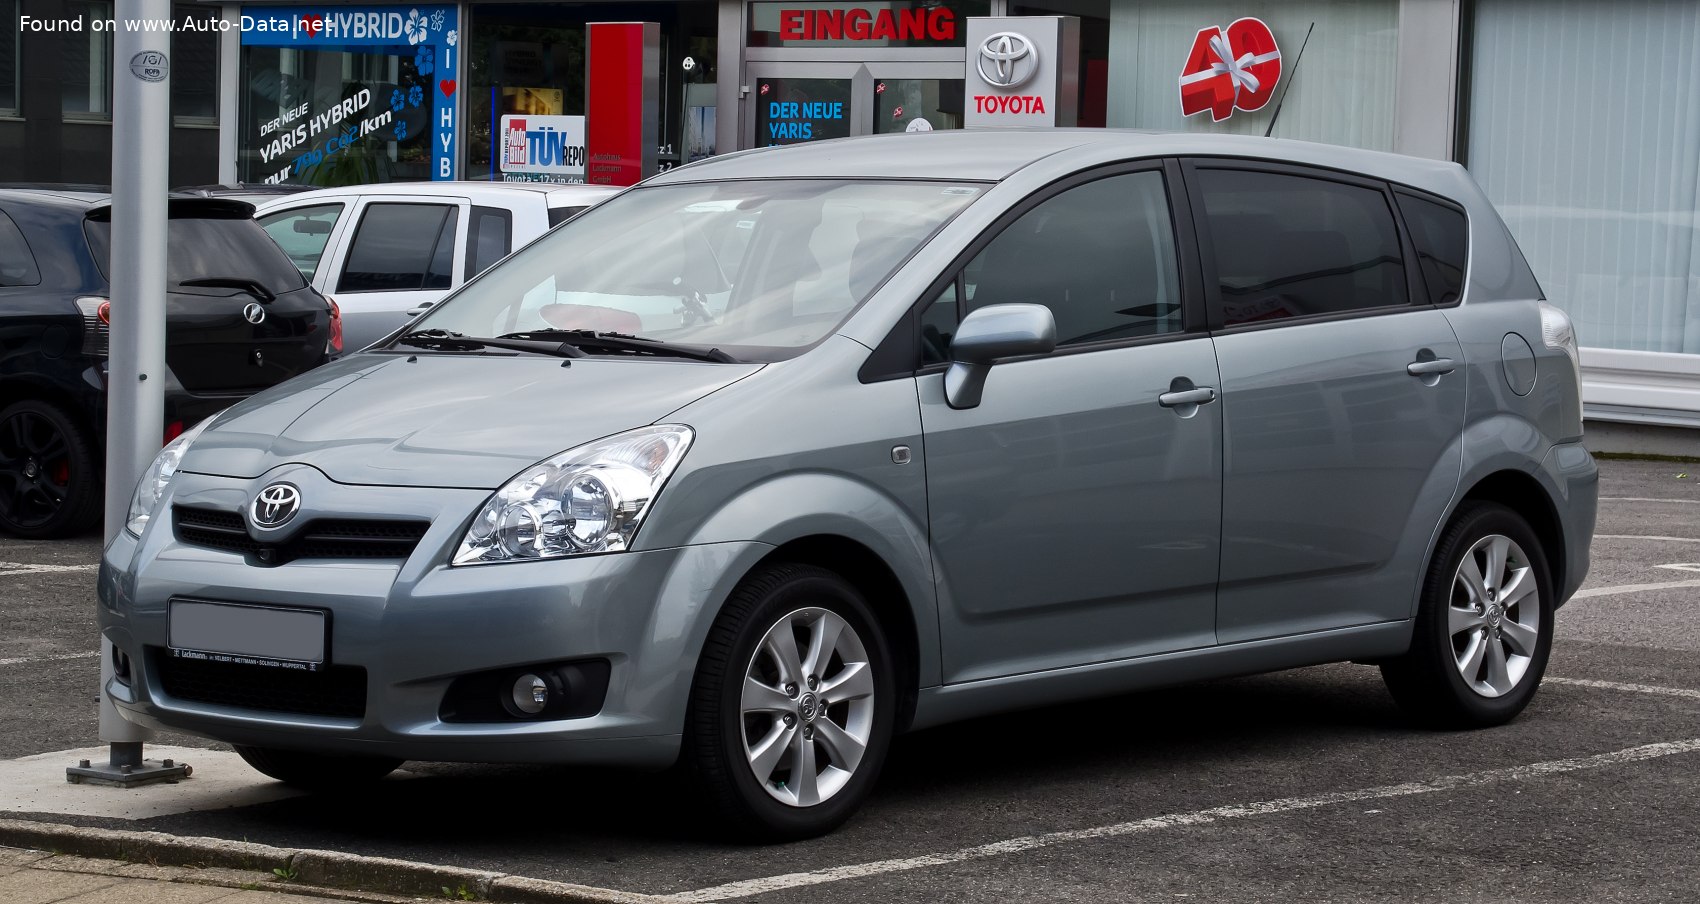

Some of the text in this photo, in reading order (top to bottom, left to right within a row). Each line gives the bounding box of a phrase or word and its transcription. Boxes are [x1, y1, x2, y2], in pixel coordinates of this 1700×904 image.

[325, 12, 404, 39] HYBRID
[780, 8, 956, 40] EINGANG
[1179, 17, 1282, 122] 40
[769, 102, 843, 119] DER NEUE
[974, 95, 1045, 114] TOYOTA
[260, 102, 309, 137] DER NEUE
[260, 88, 371, 164] YARIS HYBRID
[510, 127, 526, 147] Auto
[769, 122, 812, 139] YARIS
[509, 146, 525, 164] Bild
[526, 127, 567, 167] TÜV
[667, 143, 673, 155] 1
[264, 164, 293, 184] nur
[592, 175, 612, 184] GmbH
